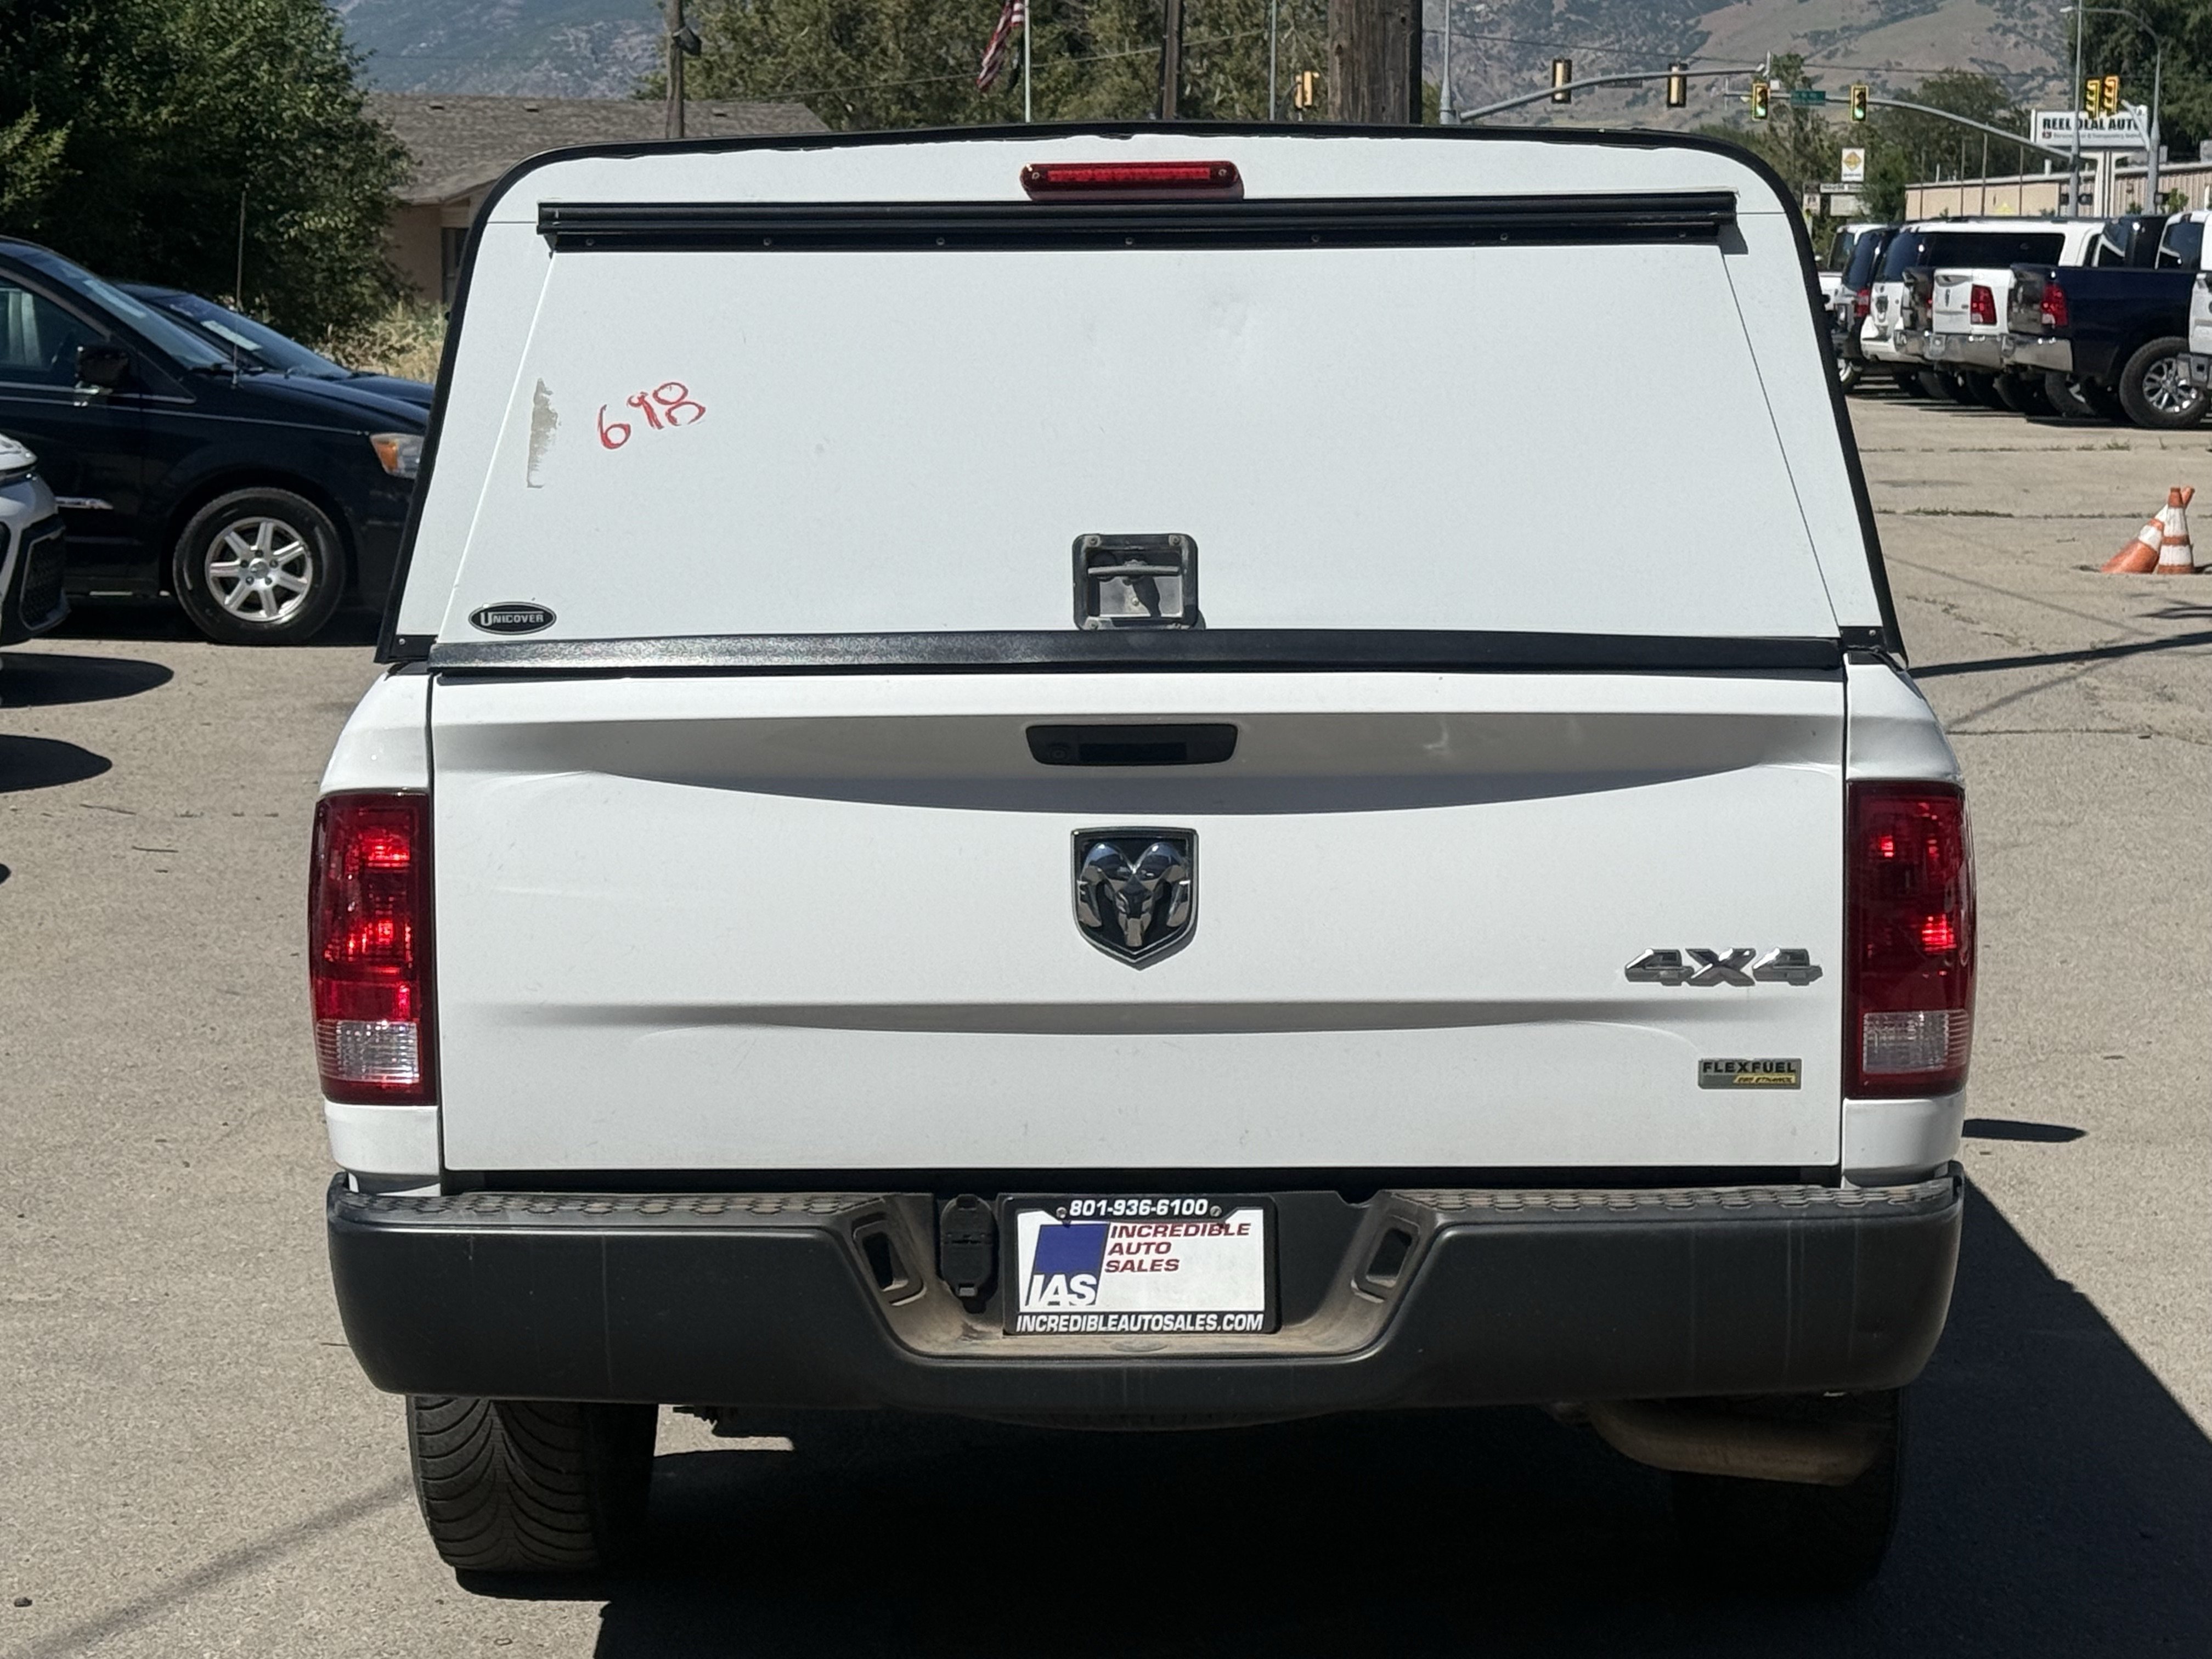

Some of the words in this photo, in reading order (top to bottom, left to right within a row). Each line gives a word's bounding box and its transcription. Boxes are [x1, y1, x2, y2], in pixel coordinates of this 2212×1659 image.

[2043, 117, 2072, 130] REEL
[597, 382, 706, 450] 698
[1069, 1199, 1209, 1216] 801-936-6100
[1110, 1223, 1251, 1238] INCREDIBLE
[1107, 1242, 1172, 1255] AUTO
[1104, 1259, 1180, 1273] SALES
[1028, 1273, 1097, 1306] IAS
[1016, 1314, 1264, 1333] INCREDIBLEAUTOSALES.COM
